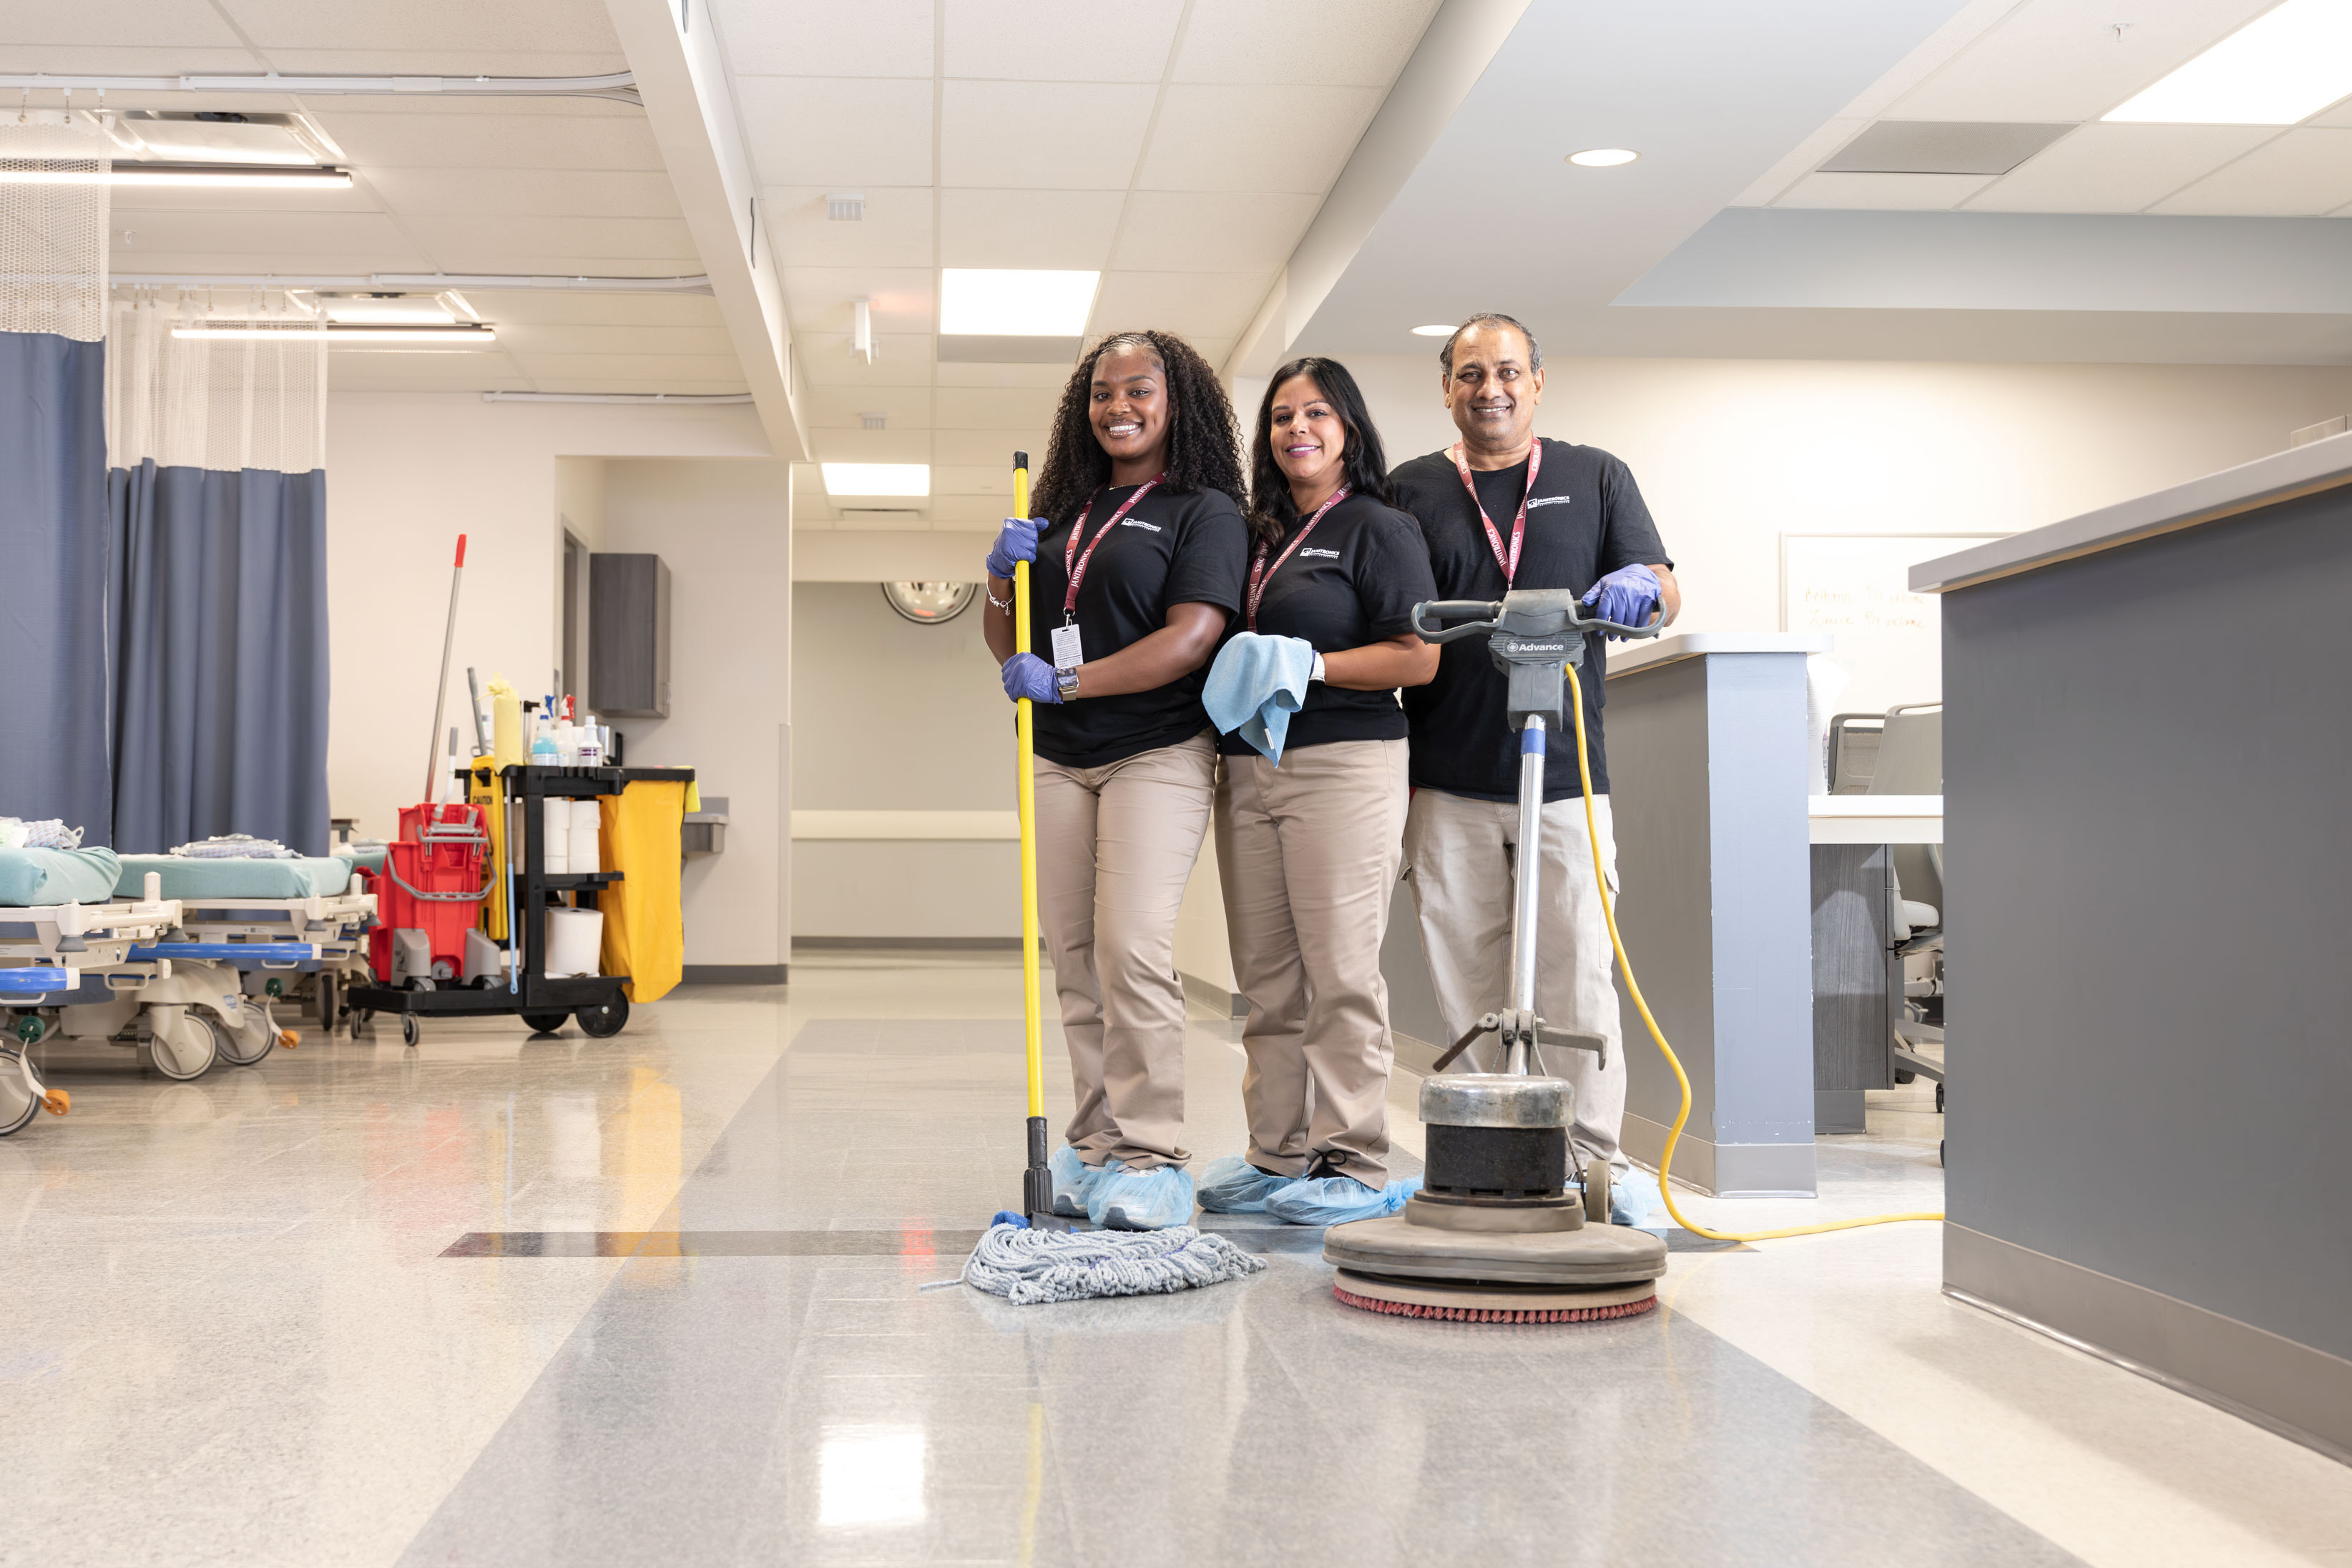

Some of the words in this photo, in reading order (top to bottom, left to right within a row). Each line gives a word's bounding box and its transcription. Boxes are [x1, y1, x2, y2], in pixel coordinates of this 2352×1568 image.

[1128, 480, 1157, 504] JANITRONICS
[1070, 512, 1086, 541] JANITRONICS
[1095, 510, 1124, 539] JANITRONICS
[1305, 501, 1333, 531] JANITRONICS
[1272, 539, 1300, 569] JANITRONICS
[1487, 529, 1507, 567] JANITRONICS
[1509, 531, 1521, 572] JANITRONICS
[1071, 548, 1092, 589] JANITRONICS
[473, 795, 493, 805] CAUTION
